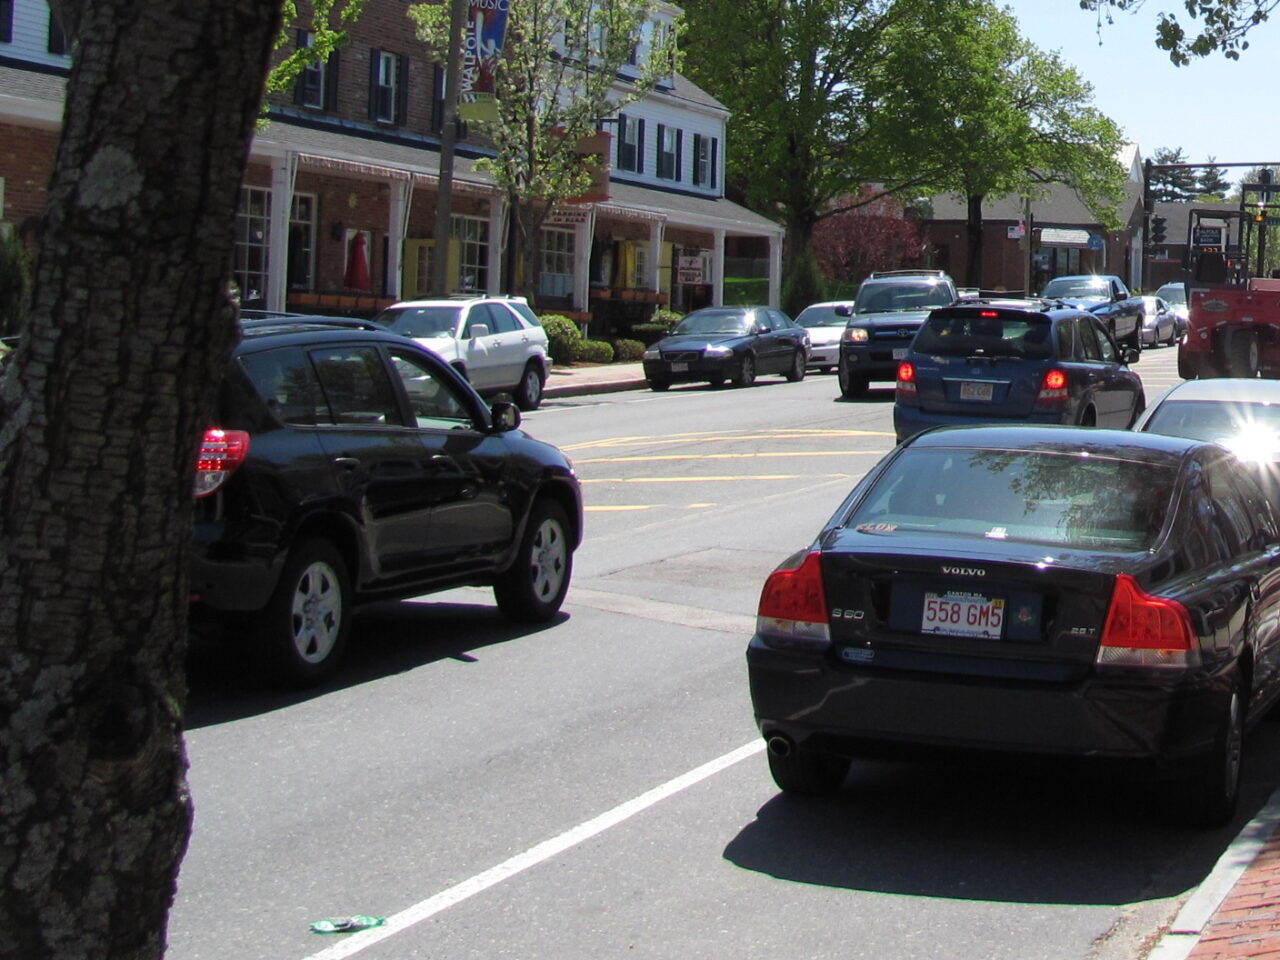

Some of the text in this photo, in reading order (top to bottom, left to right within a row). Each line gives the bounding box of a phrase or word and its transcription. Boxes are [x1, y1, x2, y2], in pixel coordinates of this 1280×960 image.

[462, 21, 477, 92] WALPOLE
[940, 565, 986, 577] VOLVO
[926, 600, 1003, 628] 558 GM5
